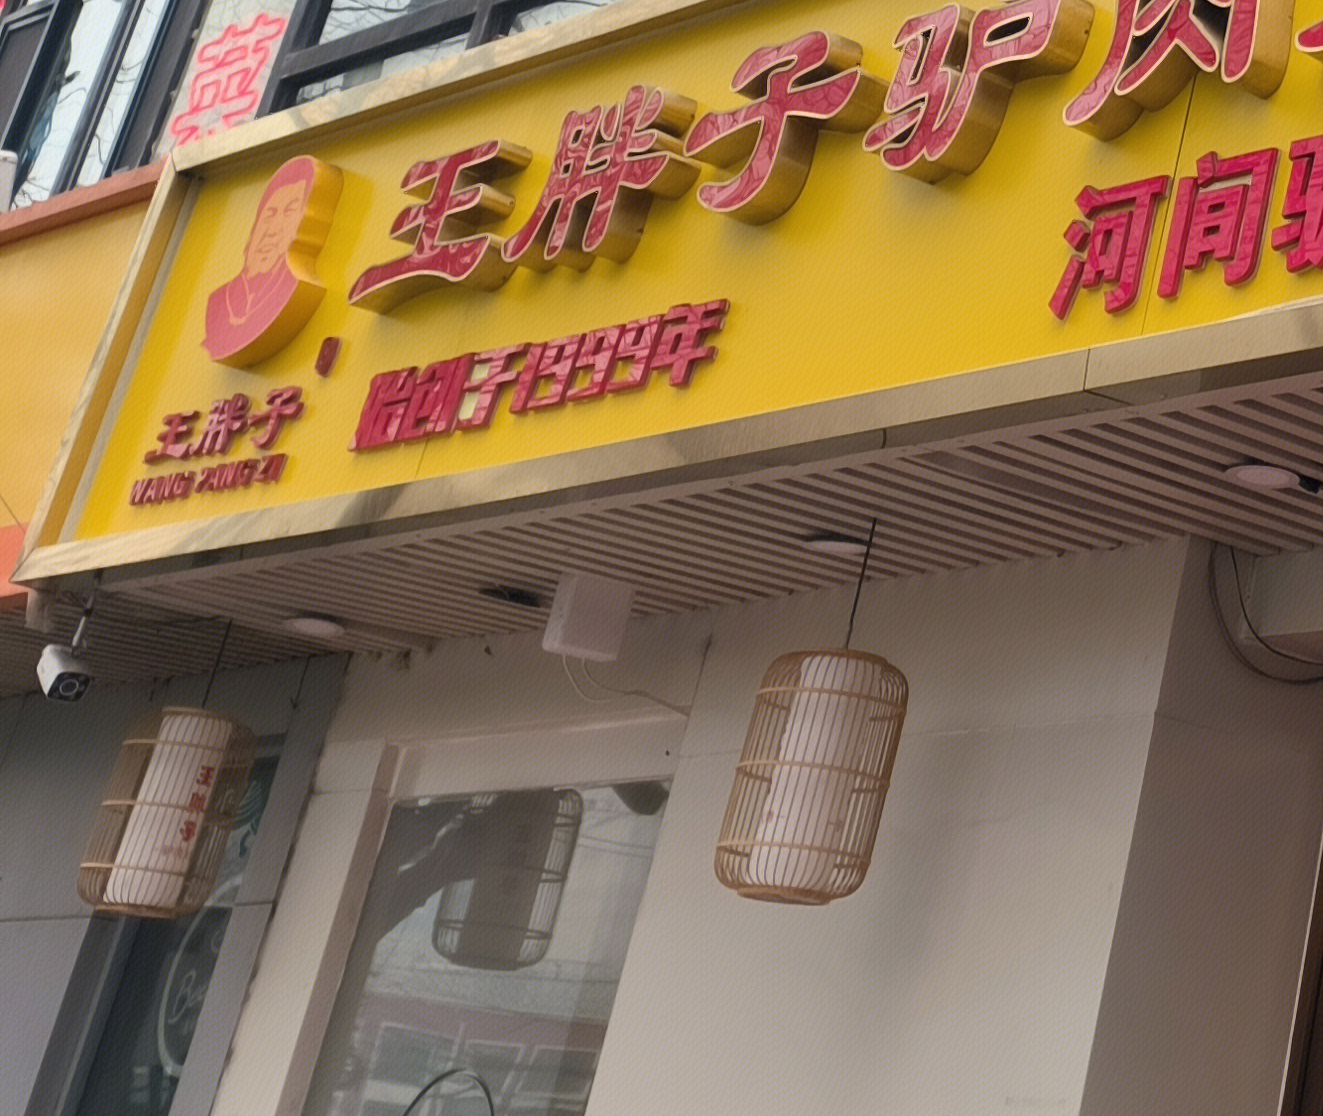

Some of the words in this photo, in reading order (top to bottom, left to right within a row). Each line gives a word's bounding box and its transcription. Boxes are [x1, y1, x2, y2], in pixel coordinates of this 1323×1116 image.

[141, 385, 306, 464] 王胖子
[129, 471, 197, 506] WANG
